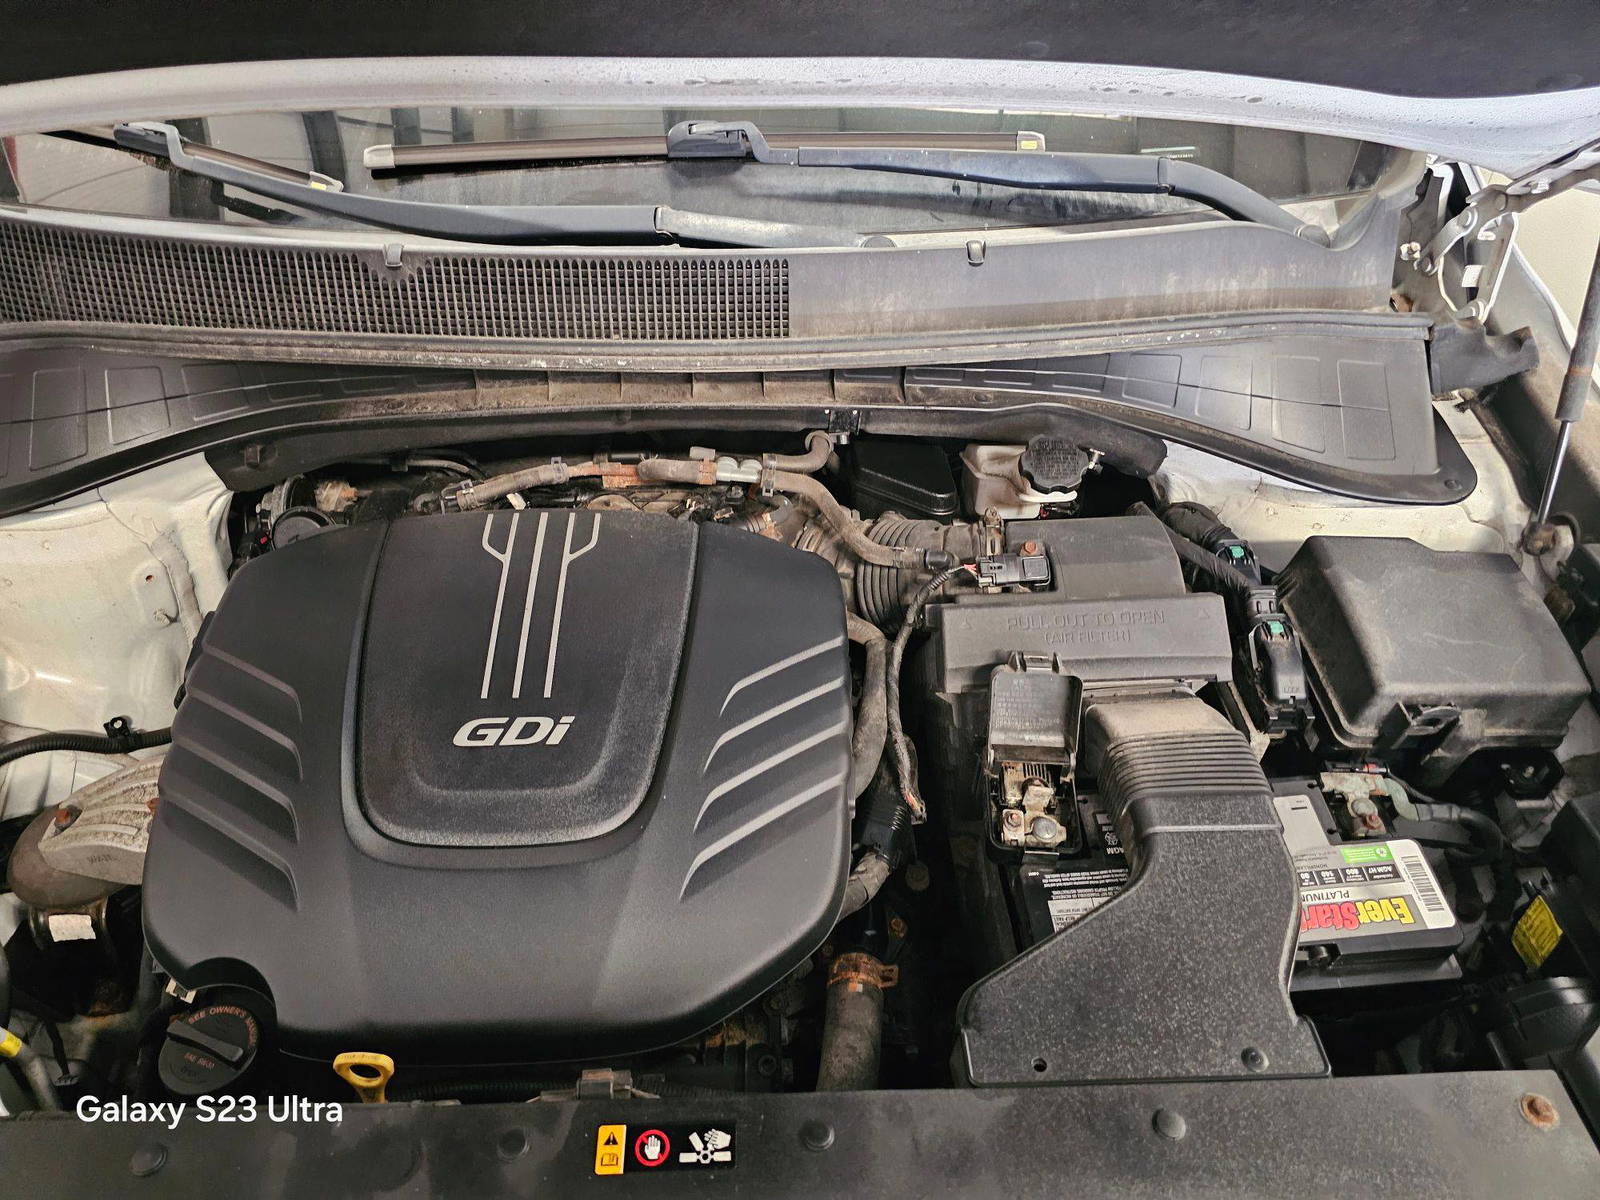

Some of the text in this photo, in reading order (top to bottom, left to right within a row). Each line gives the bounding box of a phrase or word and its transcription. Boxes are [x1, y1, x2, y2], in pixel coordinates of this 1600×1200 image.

[1007, 609, 1166, 631] PULL OUT TO OPEN
[452, 715, 576, 747] GDi
